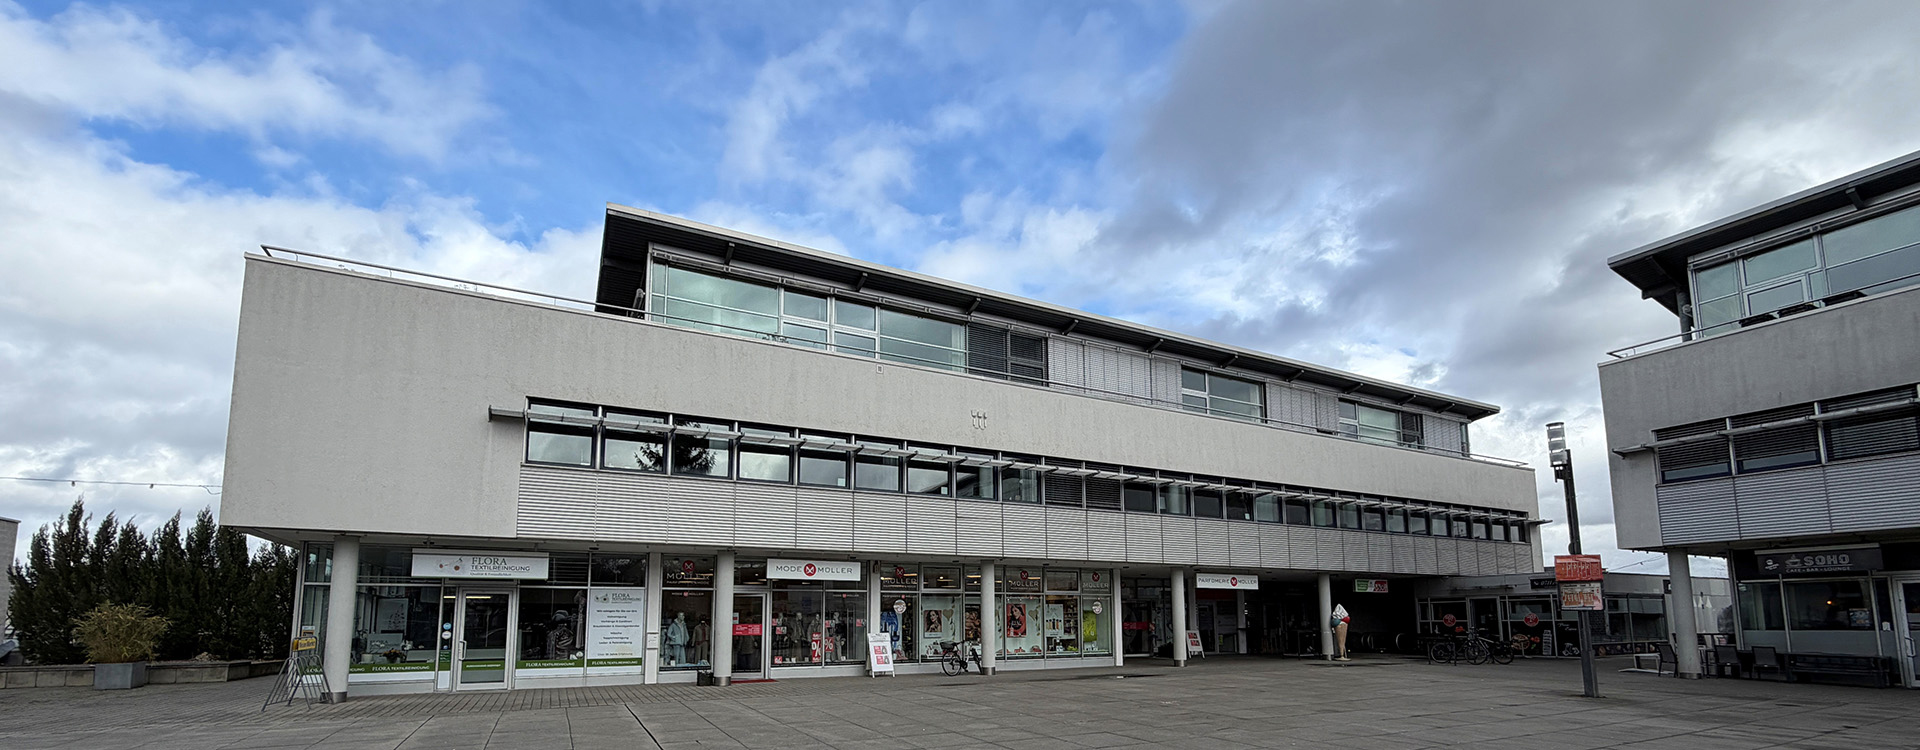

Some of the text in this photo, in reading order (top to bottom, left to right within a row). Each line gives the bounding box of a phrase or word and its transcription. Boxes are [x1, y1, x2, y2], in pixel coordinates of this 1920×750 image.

[471, 556, 507, 565] FLORA
[1803, 553, 1850, 566] SOHO
[775, 565, 802, 573] MODE
